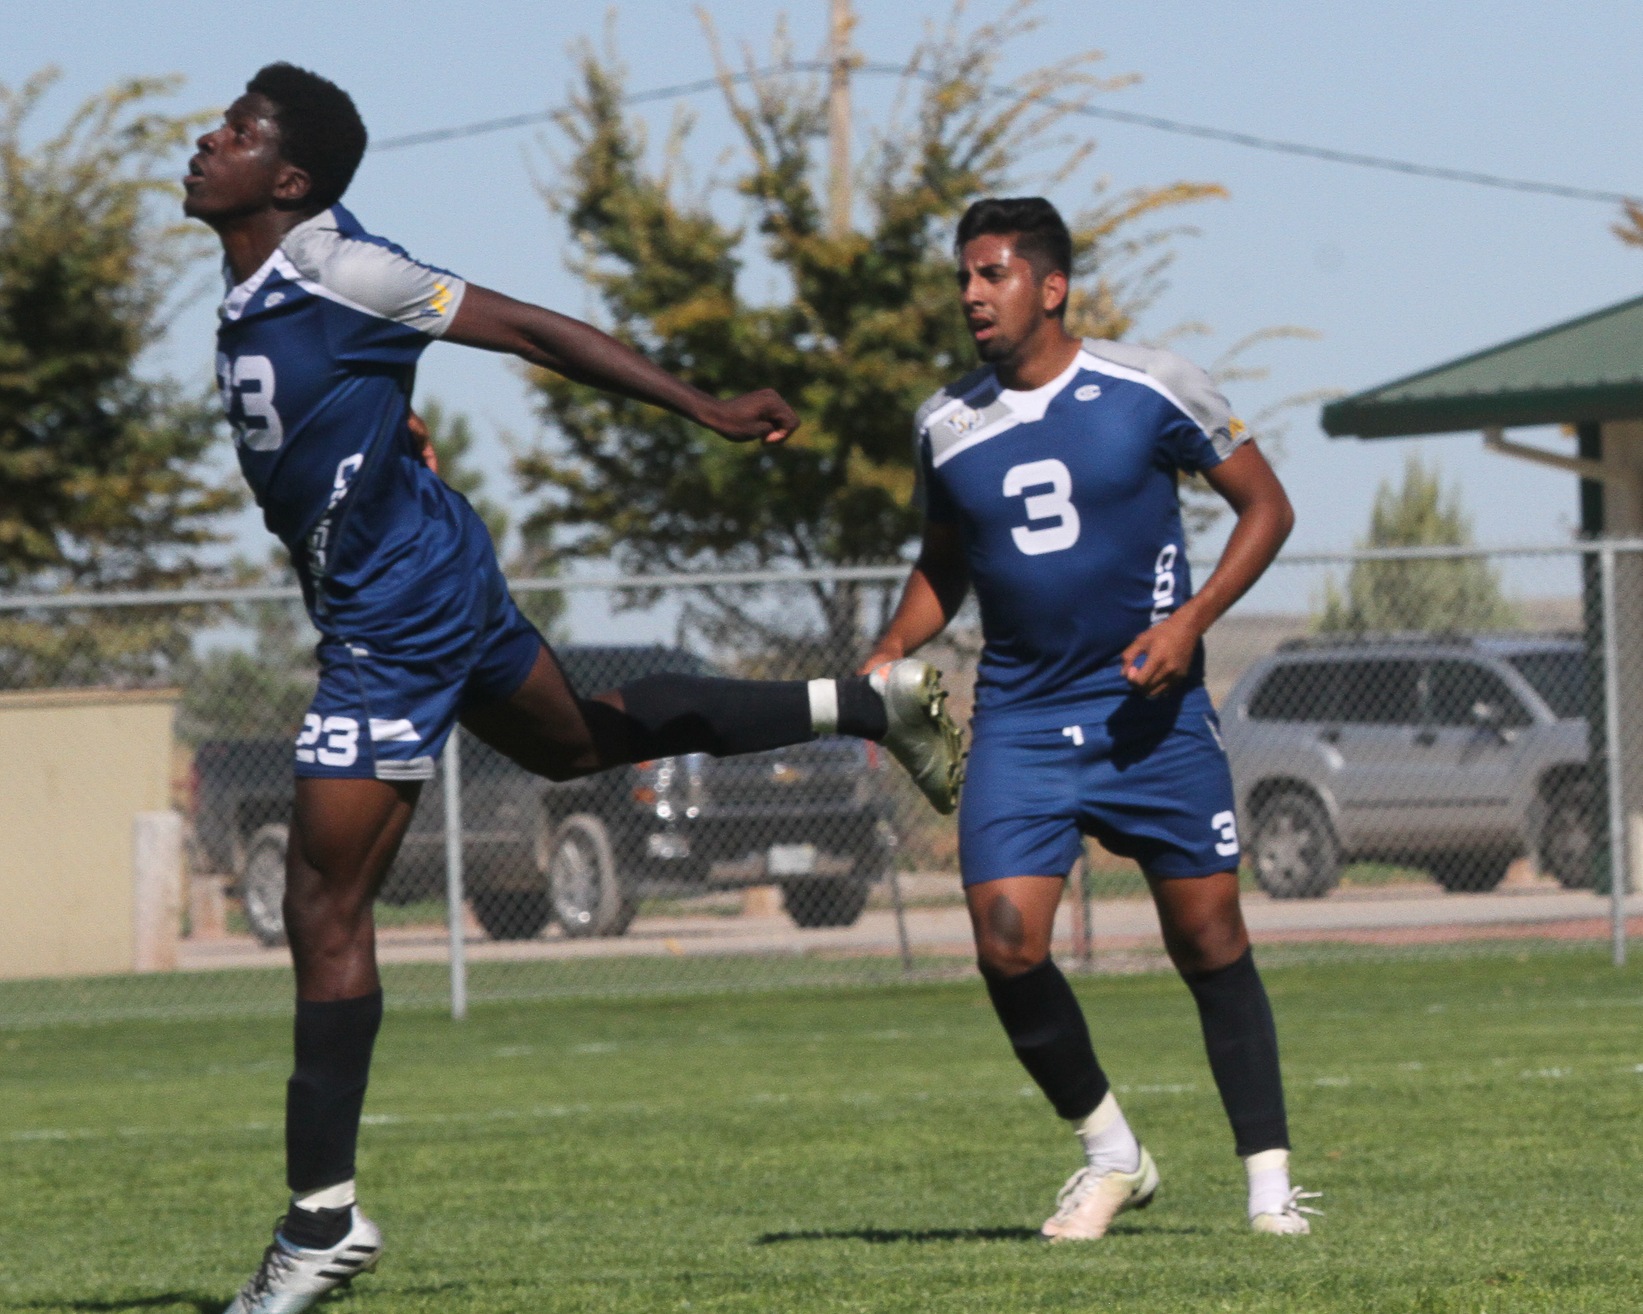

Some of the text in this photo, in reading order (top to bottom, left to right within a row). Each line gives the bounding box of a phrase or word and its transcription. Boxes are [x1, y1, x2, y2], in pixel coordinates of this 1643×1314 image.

[1003, 458, 1081, 556] 3
[296, 713, 360, 767] 23
[1211, 810, 1240, 857] 3
